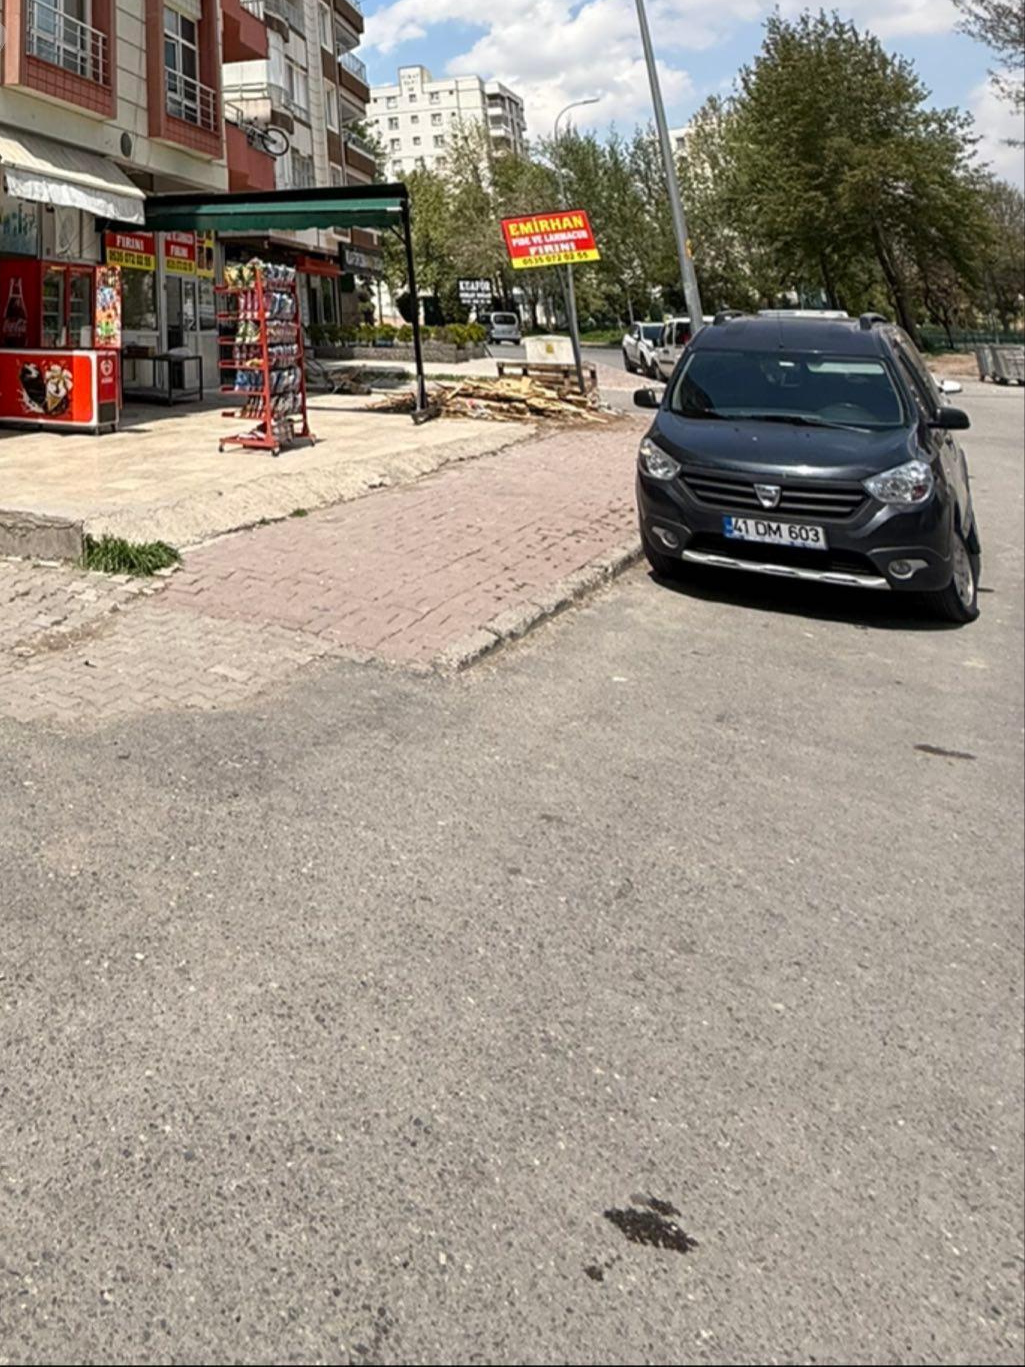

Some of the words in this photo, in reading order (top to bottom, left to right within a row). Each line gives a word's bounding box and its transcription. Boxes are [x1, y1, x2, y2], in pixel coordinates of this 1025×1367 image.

[508, 215, 585, 236] EMİRHAN
[529, 241, 577, 257] FIRINI
[732, 518, 749, 534] 41
[755, 521, 783, 538] DM
[788, 525, 820, 543] 603
